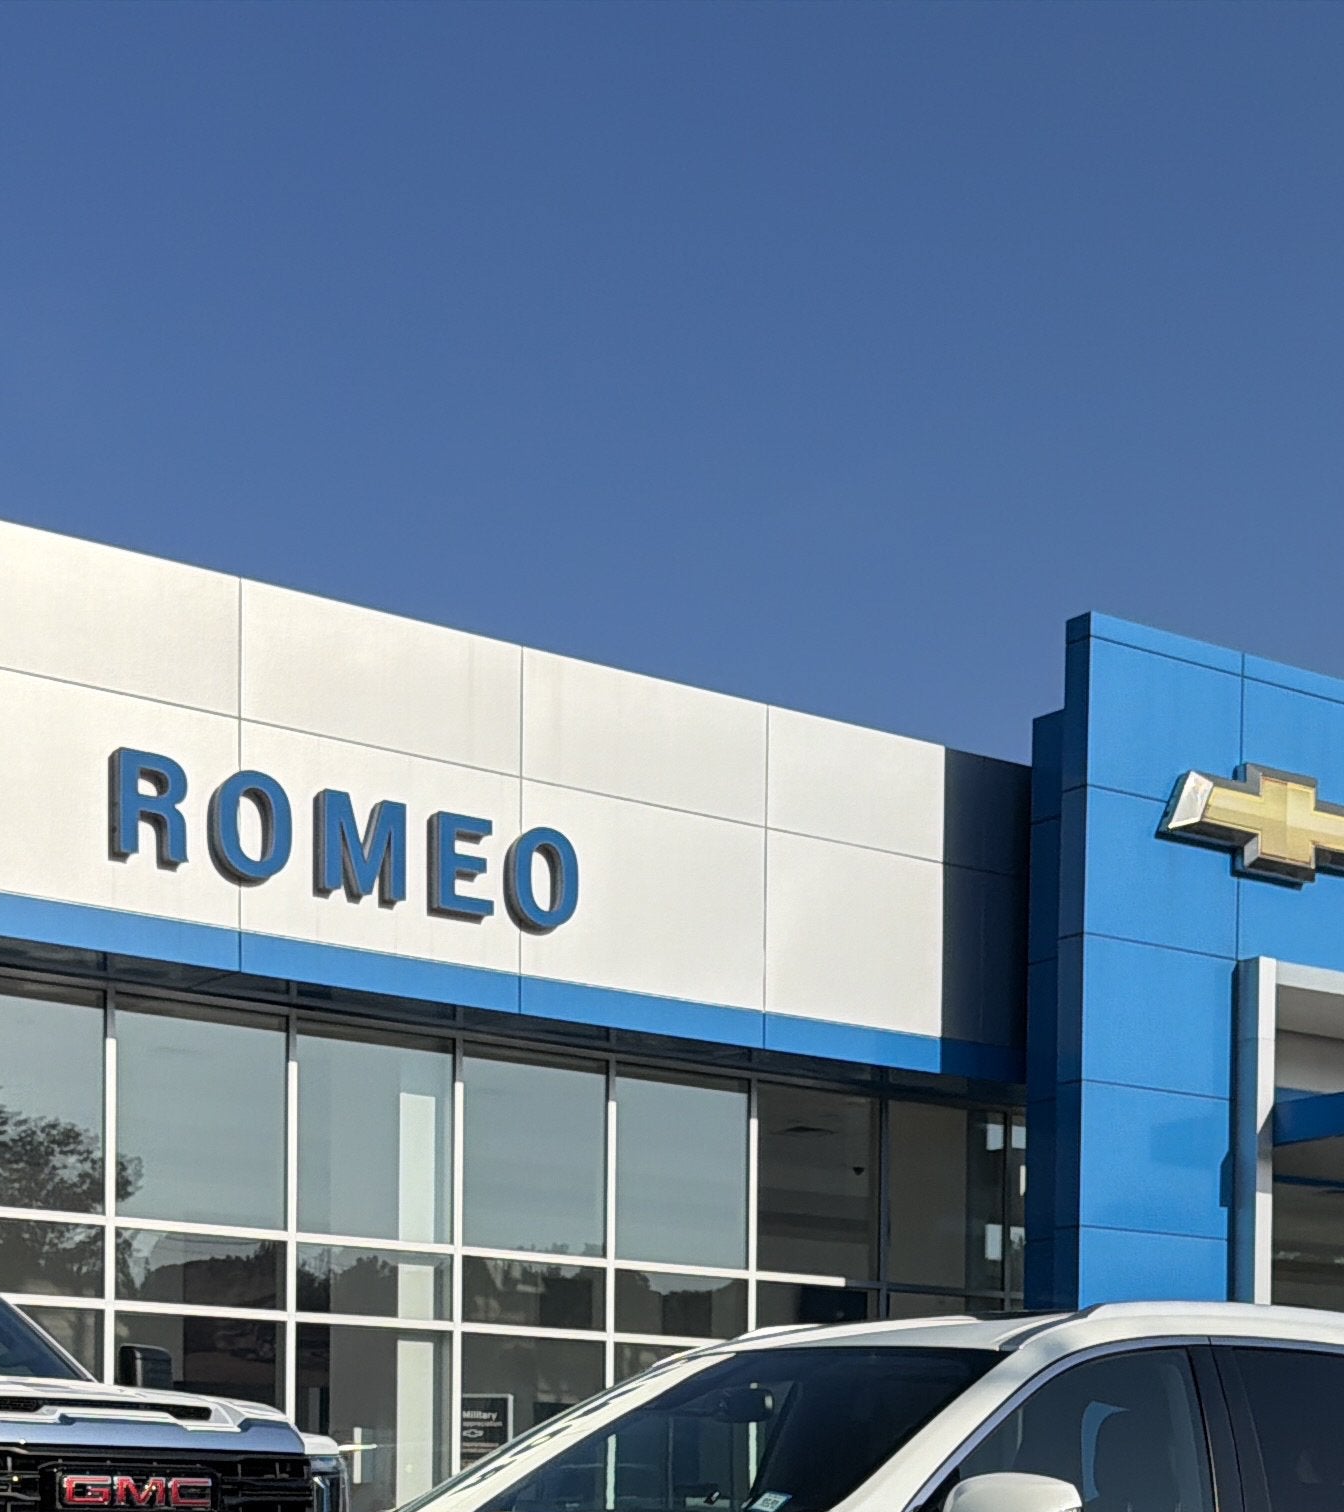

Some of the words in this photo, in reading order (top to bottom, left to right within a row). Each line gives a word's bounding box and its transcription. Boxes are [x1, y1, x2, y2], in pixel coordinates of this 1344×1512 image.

[109, 747, 579, 935] ROMEO
[462, 1411, 497, 1421] Military
[64, 1475, 212, 1507] GMC
